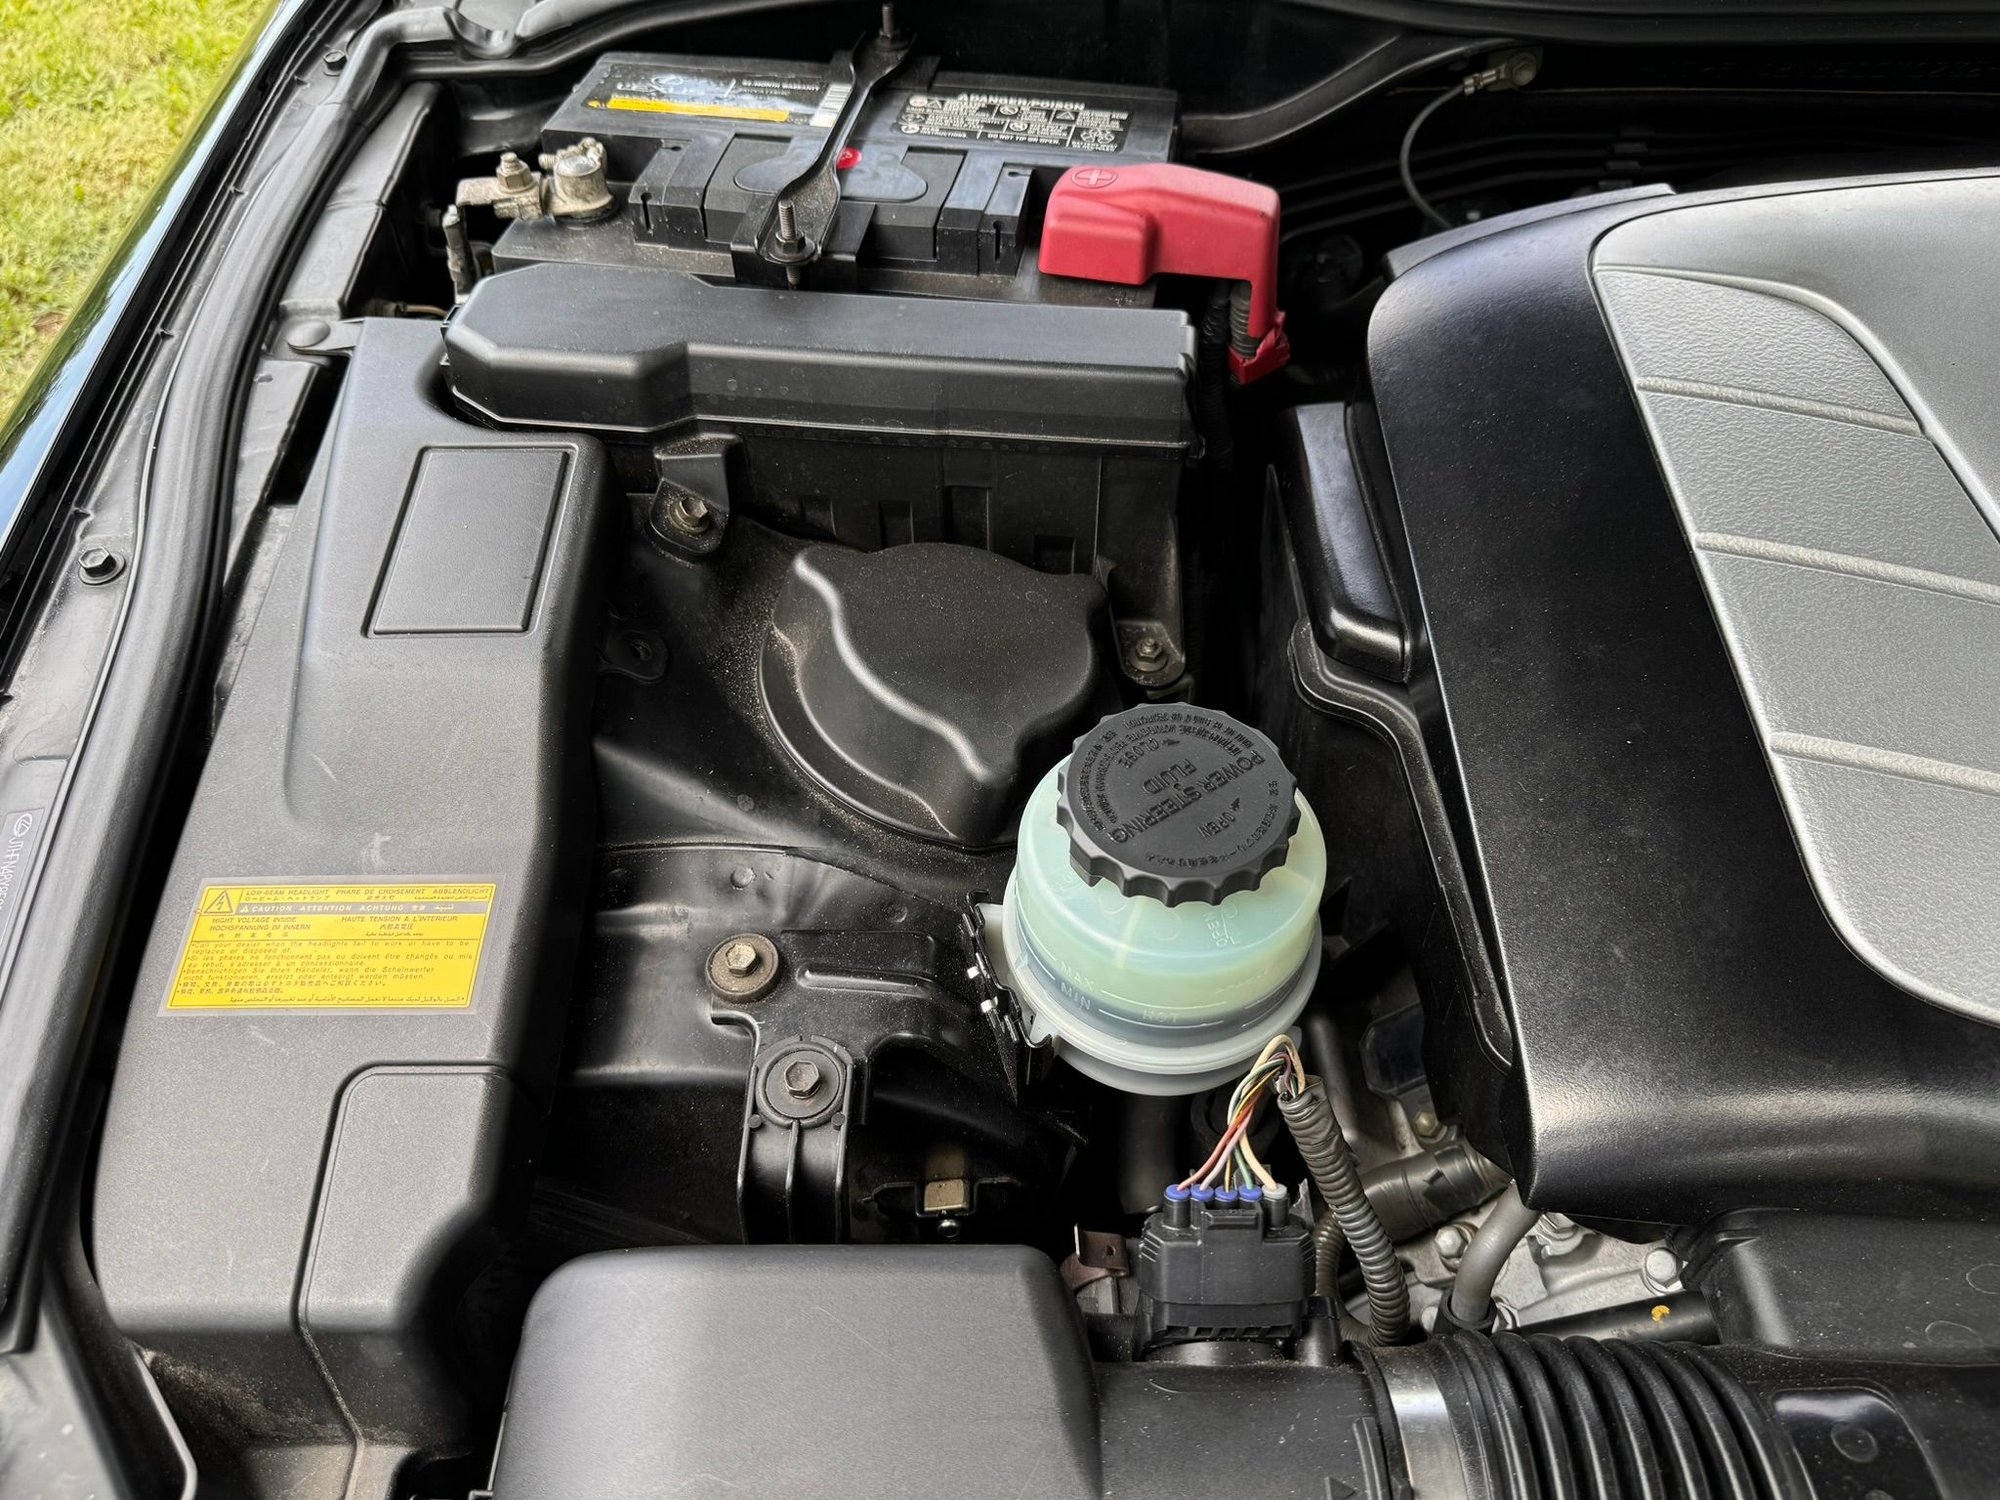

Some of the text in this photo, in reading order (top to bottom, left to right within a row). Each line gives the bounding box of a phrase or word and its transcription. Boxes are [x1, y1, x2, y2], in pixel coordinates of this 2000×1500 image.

[1117, 738, 1161, 769] CLOSE
[1141, 757, 1198, 796] FLUID
[1199, 749, 1266, 794] POWER
[1106, 785, 1204, 844] STEERING
[1195, 808, 1238, 840] OPEN
[288, 888, 329, 896] HEADLIGHT
[252, 904, 404, 913] CAUTION ATTENTION ACHTUNG
[1060, 960, 1095, 991] MAX
[1060, 982, 1092, 1011] MIN
